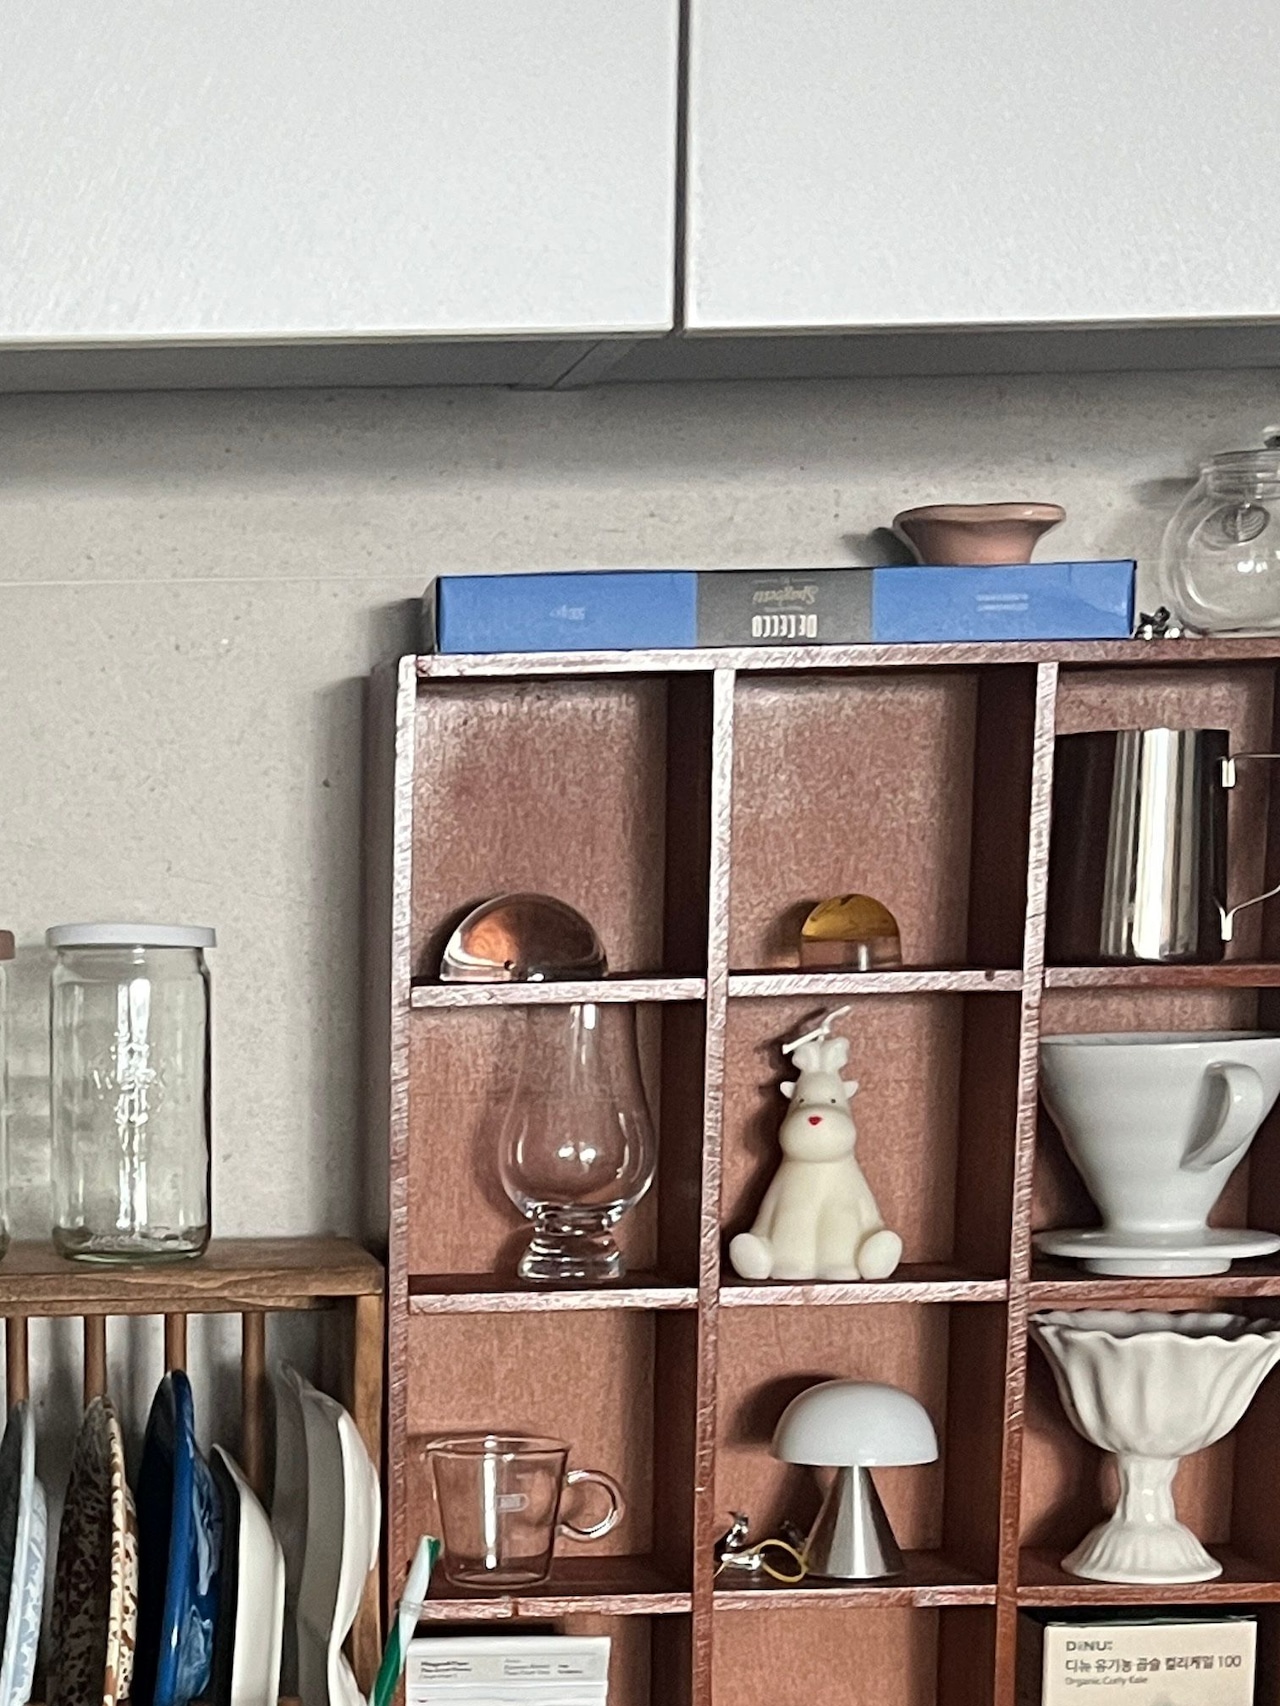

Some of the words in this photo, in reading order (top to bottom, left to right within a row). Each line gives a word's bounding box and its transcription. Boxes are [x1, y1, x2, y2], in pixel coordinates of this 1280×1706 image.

[1095, 1658, 1132, 1673] 유기농
[1218, 1655, 1242, 1668] 100
[1065, 1677, 1101, 1687] Organic
